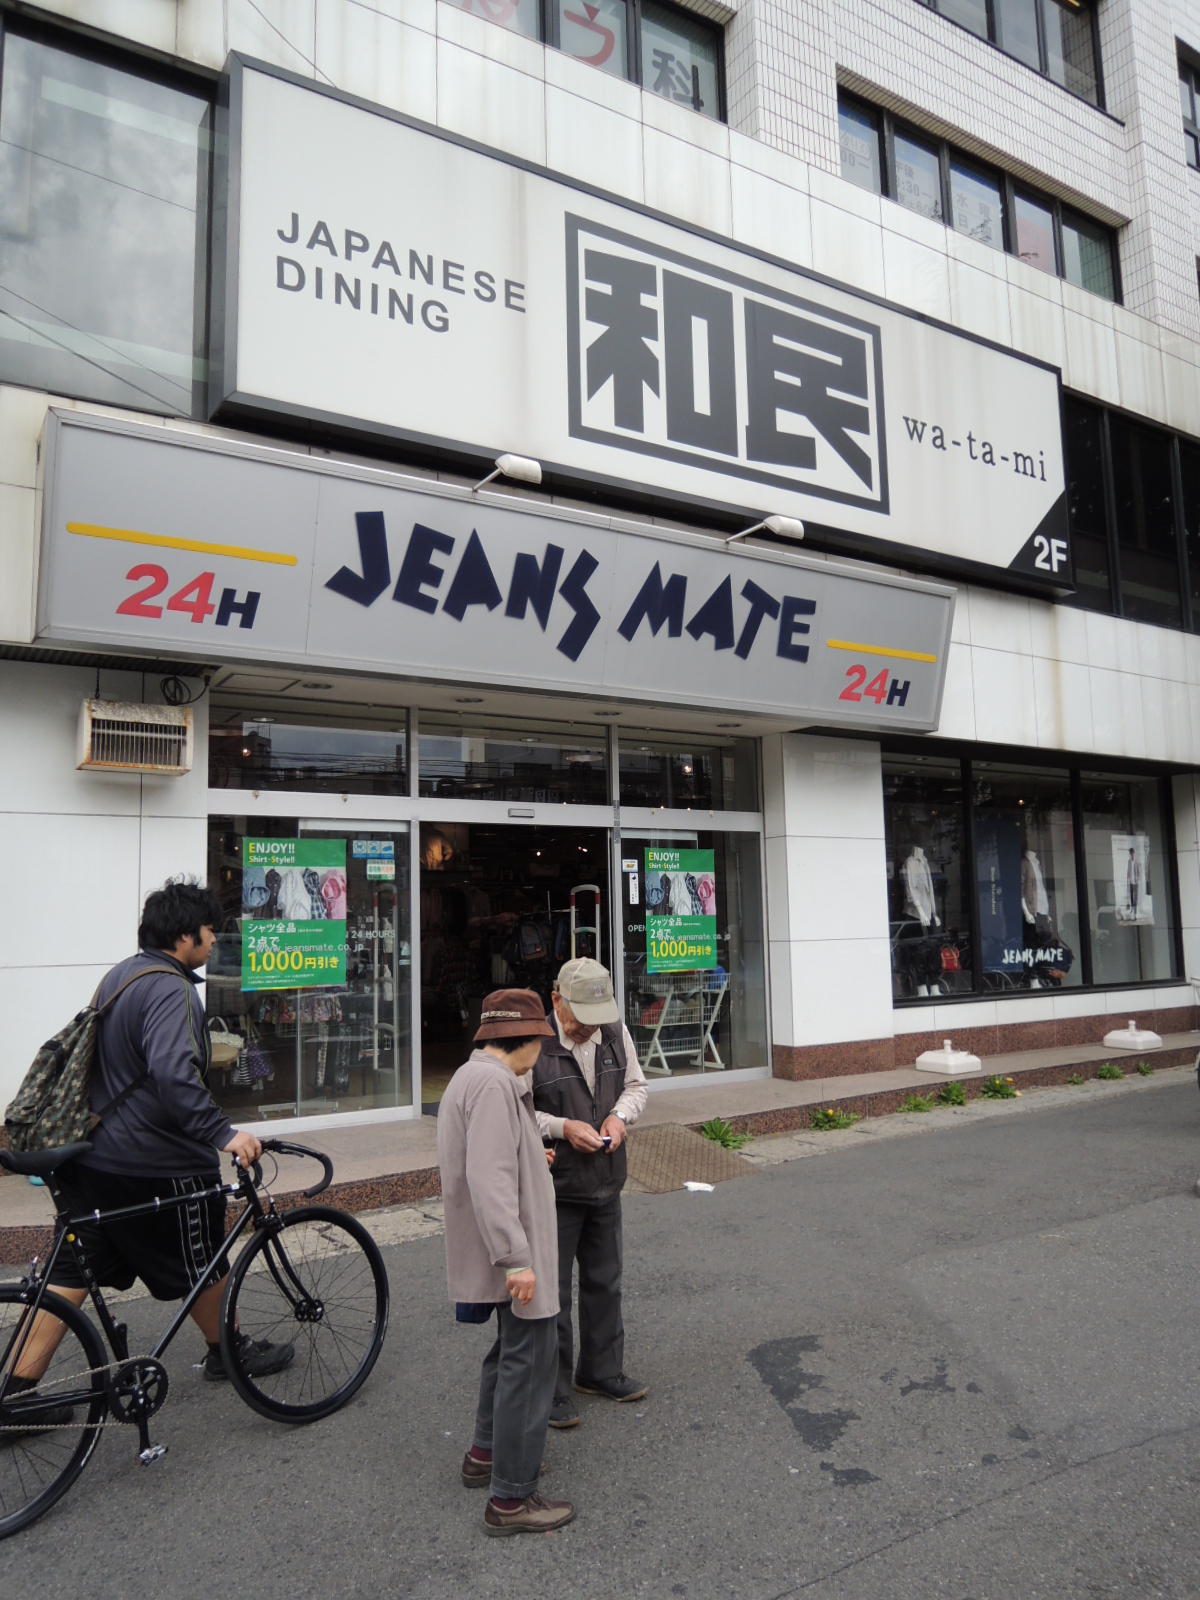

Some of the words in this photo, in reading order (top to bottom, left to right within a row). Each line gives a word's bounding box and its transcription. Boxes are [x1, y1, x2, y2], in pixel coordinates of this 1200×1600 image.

[652, 48, 704, 112] 科
[276, 211, 526, 314] JAPANESE
[276, 255, 450, 333] DINING
[584, 248, 874, 493] 和民
[902, 415, 1047, 482] wa-ta-mi
[1033, 534, 1068, 573] 2F
[115, 563, 262, 630] 24H
[324, 510, 602, 663] JEANS
[616, 559, 817, 664] MATE
[838, 664, 911, 707] 24H
[248, 842, 295, 854] ENJOY!!
[648, 852, 680, 862] ENJOY!!
[248, 922, 297, 934] シャツ全品
[351, 930, 363, 939] 24
[365, 929, 396, 940] HOURS
[650, 917, 683, 927] シャツ全品
[247, 935, 280, 950] 2点で
[650, 940, 712, 959] 1,000円引き
[1002, 948, 1034, 968] JEANS
[1035, 947, 1064, 963] MATE
[247, 951, 340, 973] 1,000円引き
